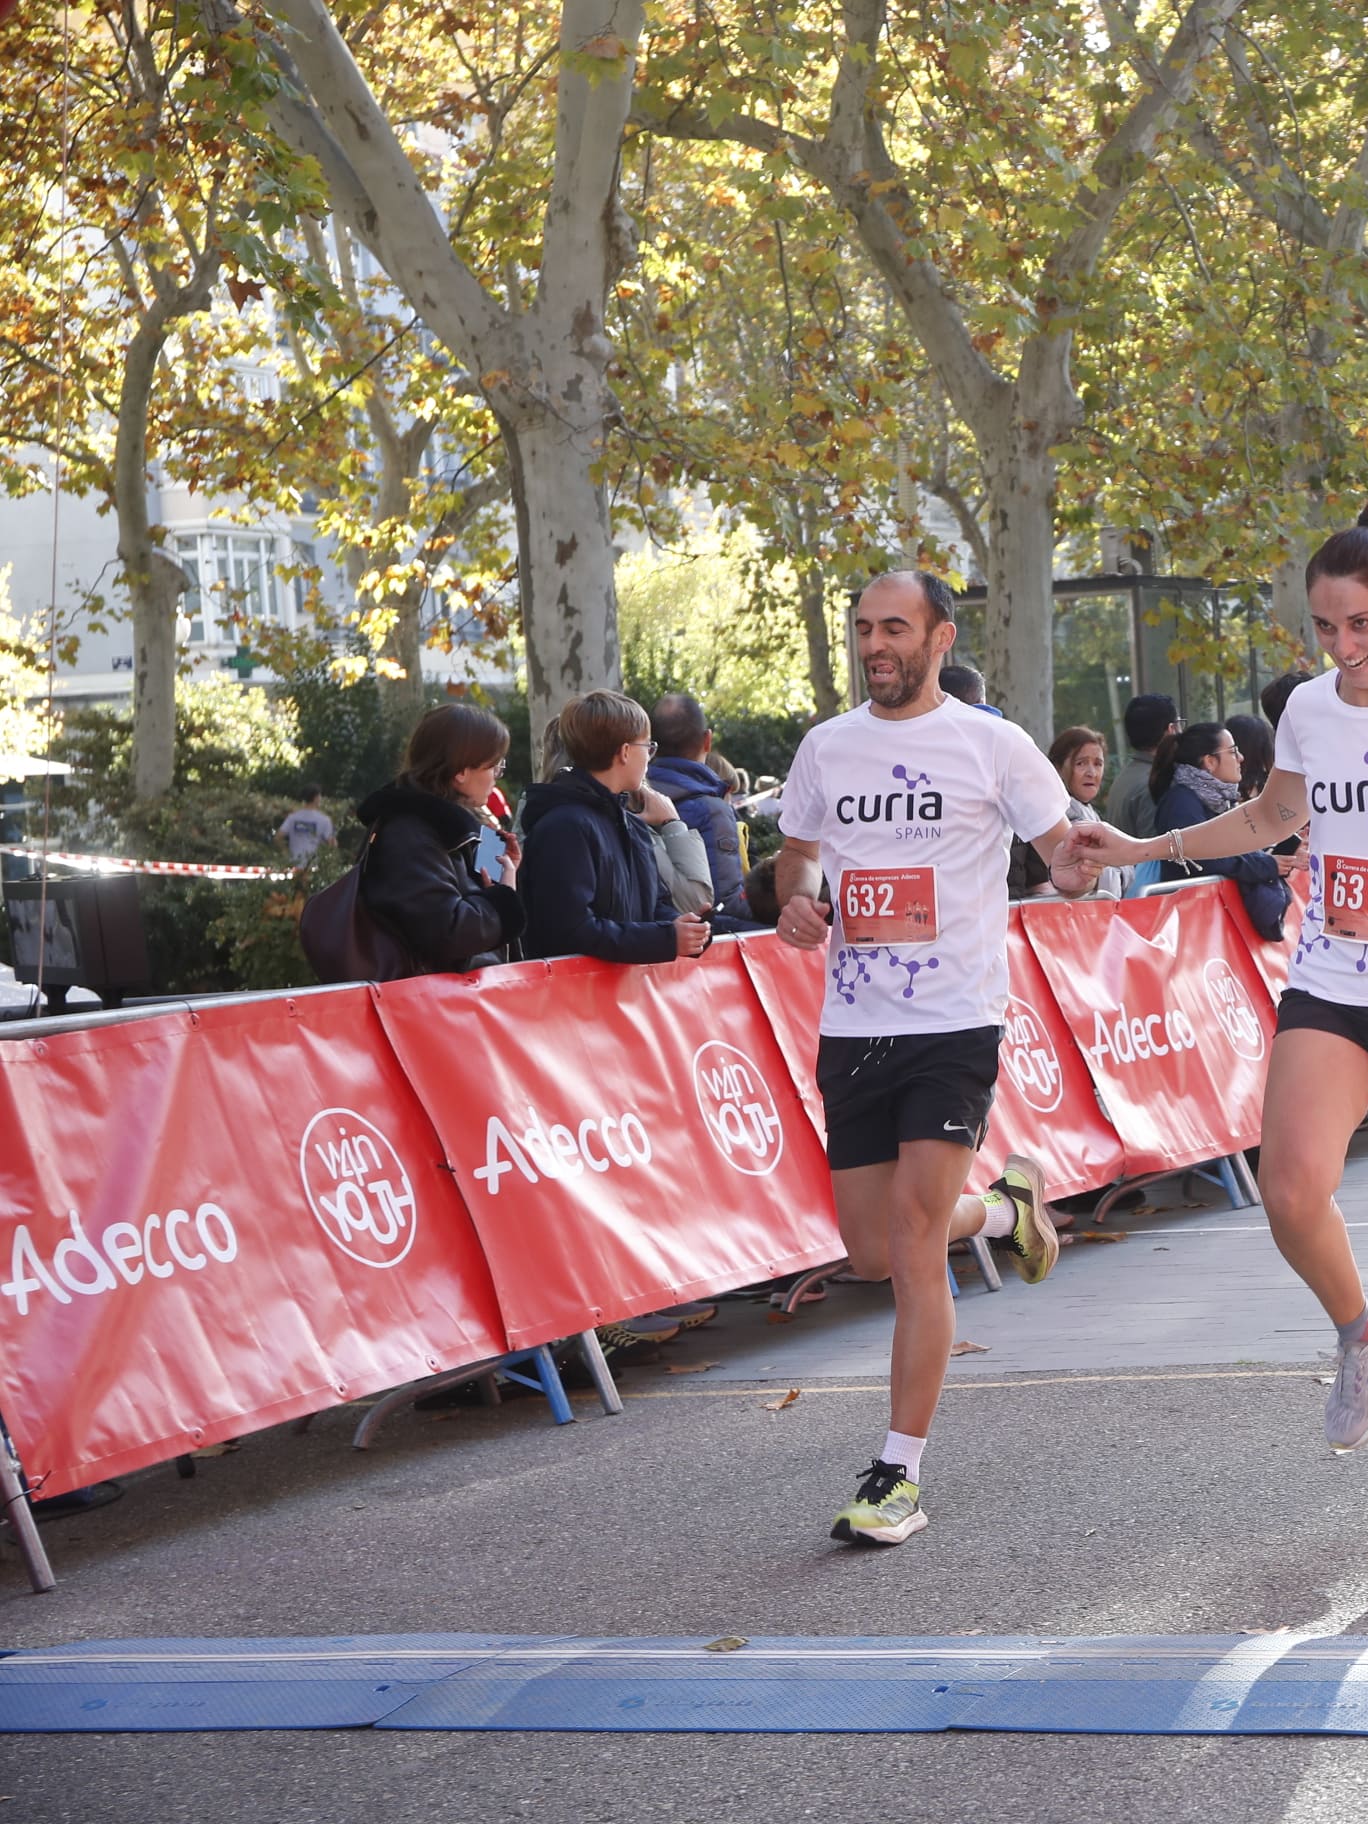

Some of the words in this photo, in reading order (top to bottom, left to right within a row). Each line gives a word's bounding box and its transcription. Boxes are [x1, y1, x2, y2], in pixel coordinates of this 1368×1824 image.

[836, 791, 942, 824] curia
[895, 827, 942, 840] SPAIN
[846, 883, 895, 917] 632
[1091, 1002, 1196, 1069] Adecco
[473, 1106, 652, 1194] Adecco
[1, 1203, 238, 1315] Adecco
